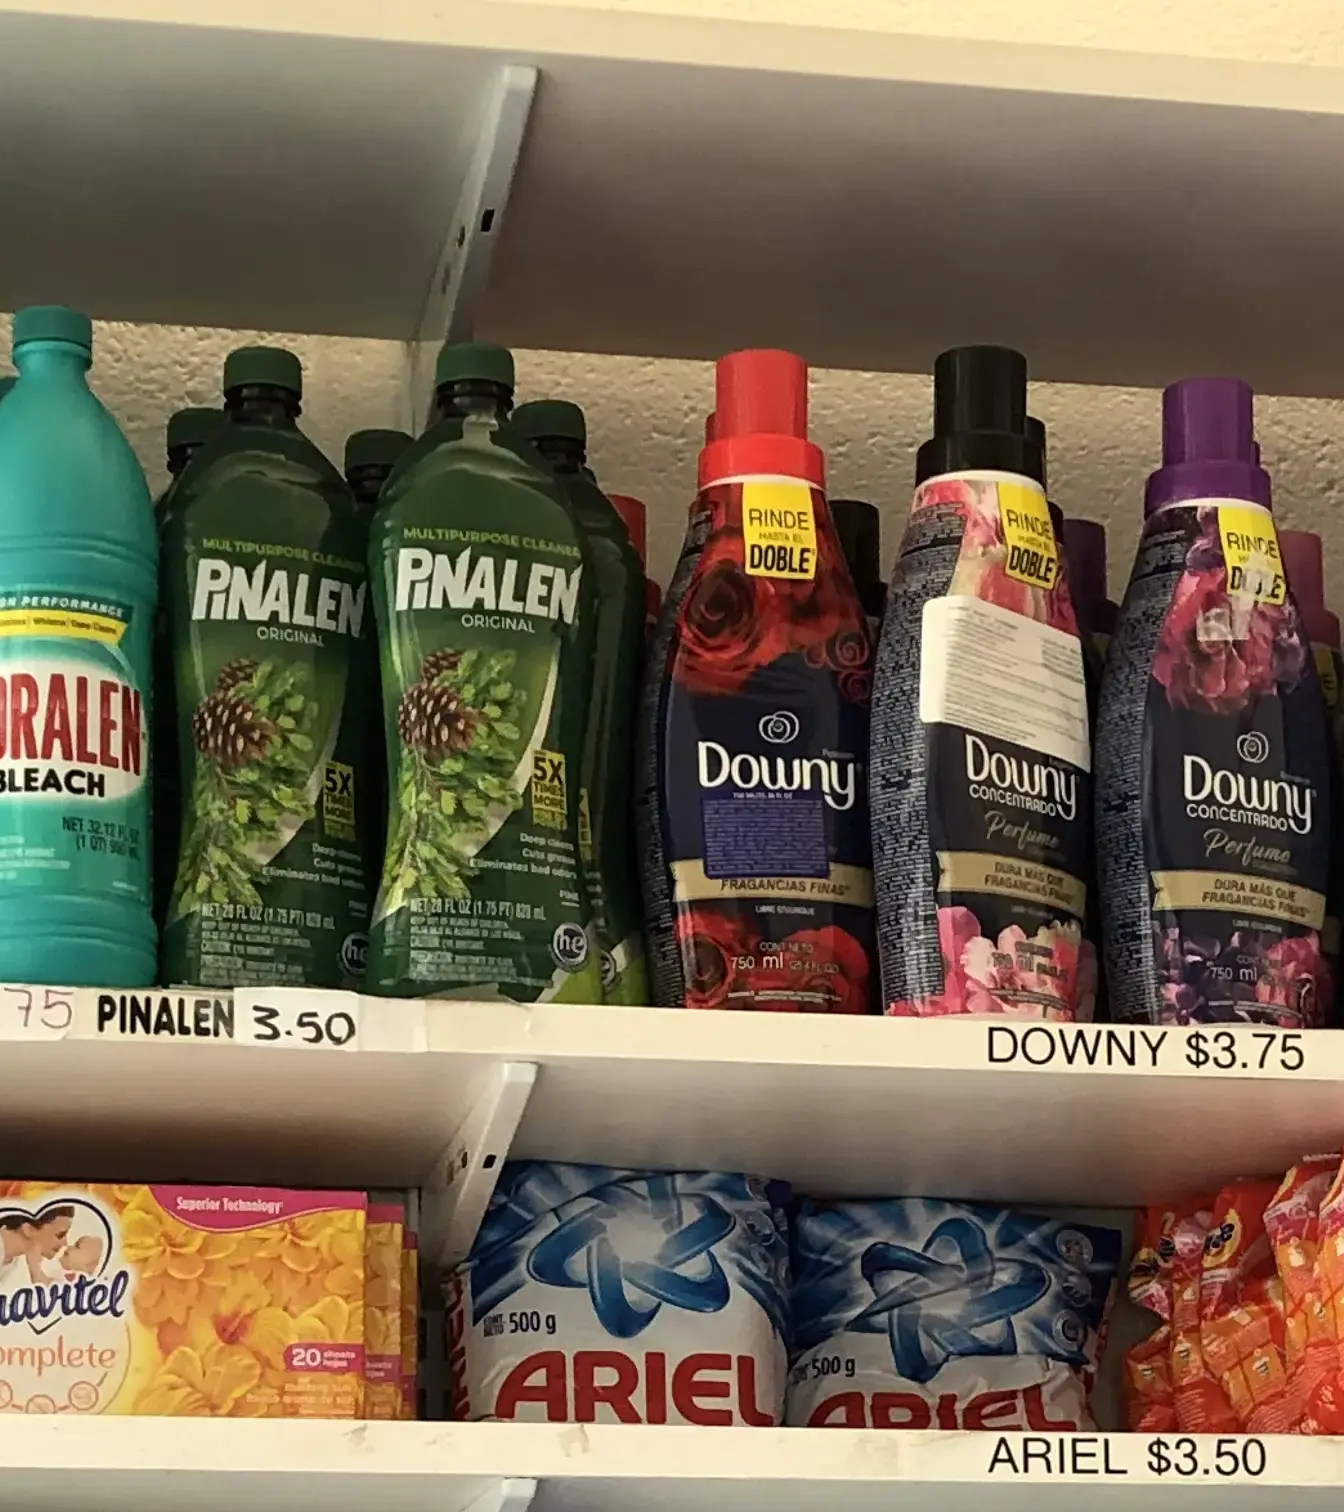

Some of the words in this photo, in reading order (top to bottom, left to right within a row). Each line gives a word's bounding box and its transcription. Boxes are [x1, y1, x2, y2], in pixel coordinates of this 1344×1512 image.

[749, 508, 809, 531] RINDE
[22, 596, 124, 617] PERFORMANCE
[461, 614, 535, 634] ORIGINAL
[697, 741, 855, 810] Downy
[965, 734, 1076, 821] Downy
[1183, 754, 1312, 834] Downy
[1186, 803, 1288, 831] CONCENTRADO
[721, 879, 812, 893] FRAGANCIAS
[97, 993, 234, 1038] PINALEN
[252, 1006, 357, 1046] 3.50
[988, 1027, 1167, 1068] DOWNY
[1185, 1032, 1305, 1072] $3.75
[177, 1196, 220, 1210] Superior
[495, 1350, 779, 1428] ARIEL
[987, 1436, 1128, 1476] ARIEL
[1147, 1437, 1267, 1478] $3.50
